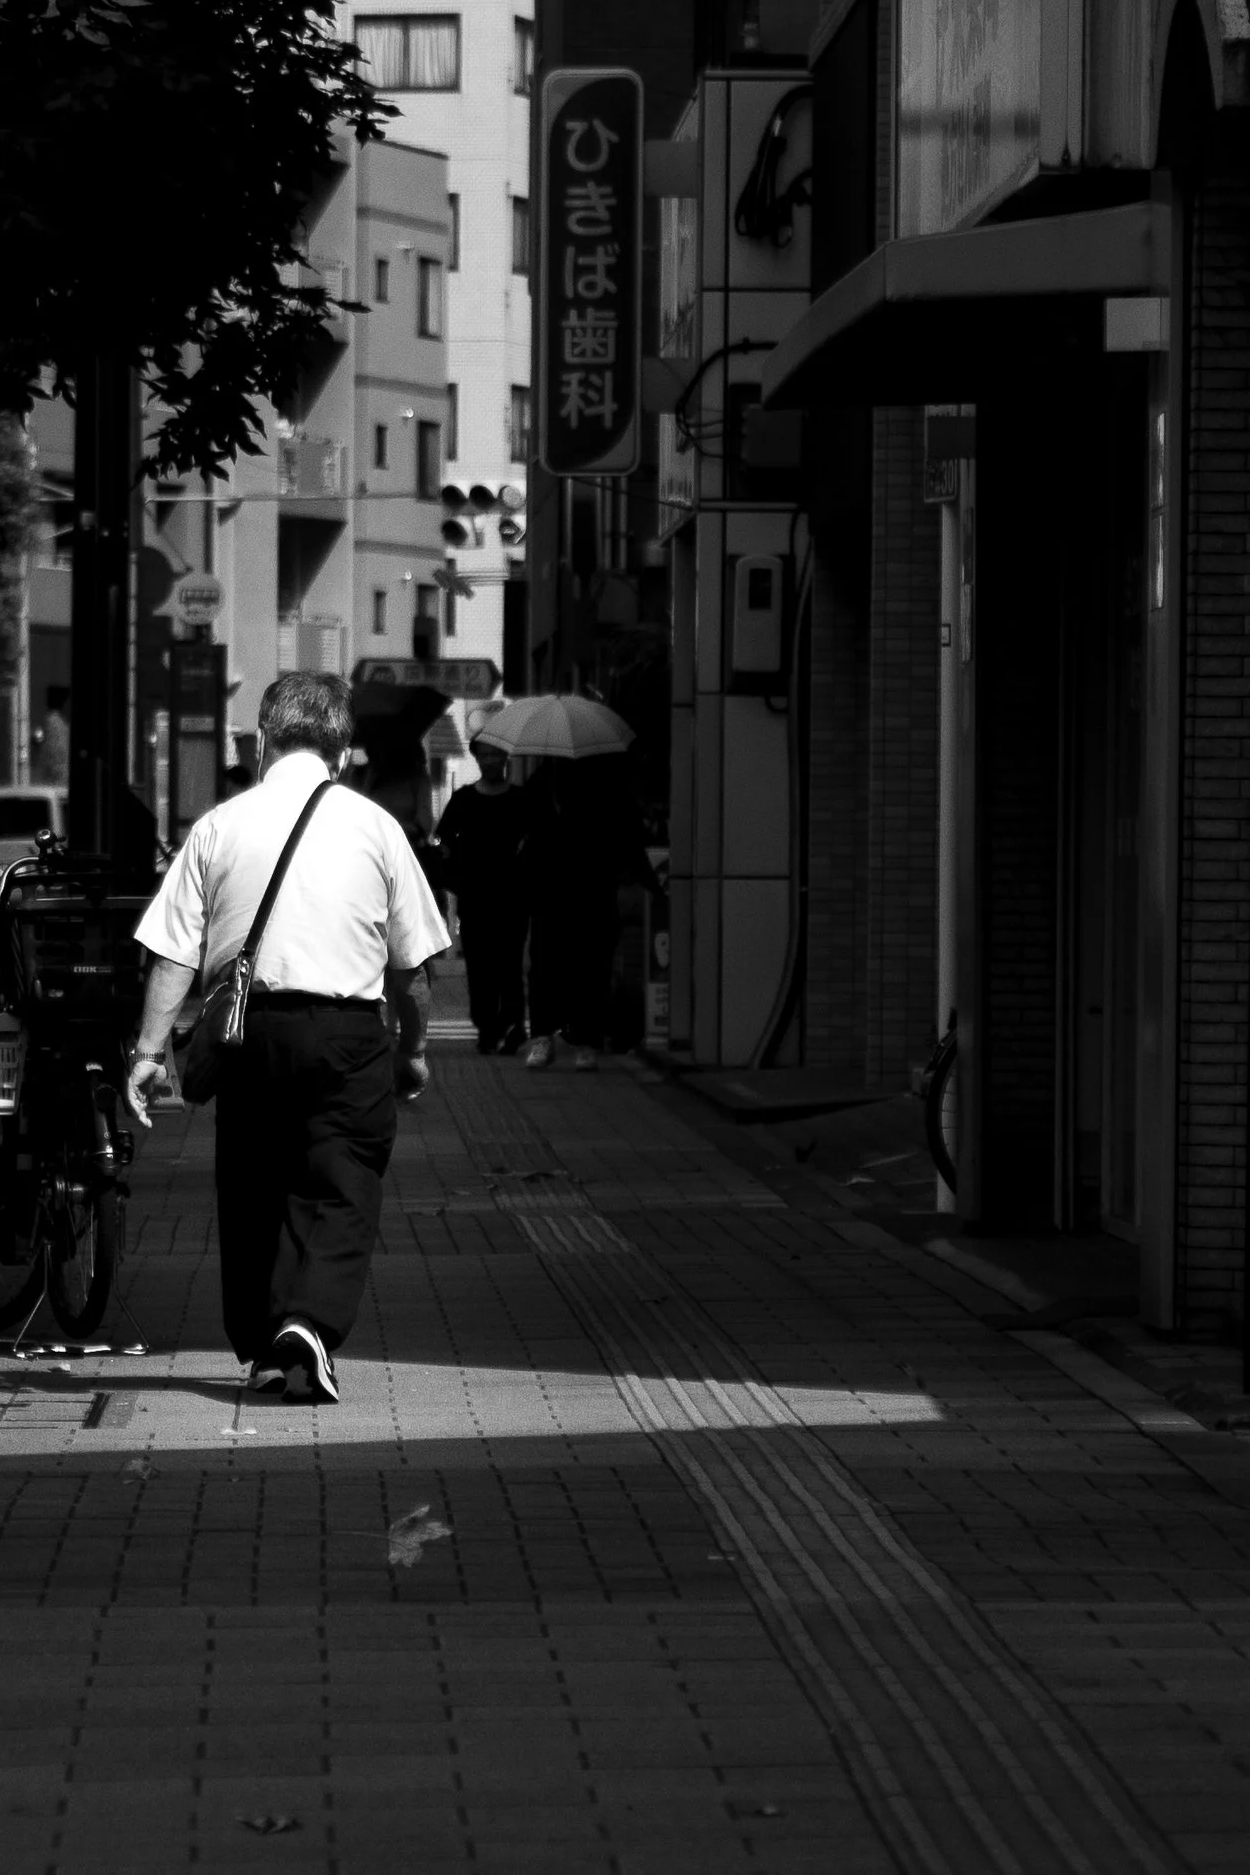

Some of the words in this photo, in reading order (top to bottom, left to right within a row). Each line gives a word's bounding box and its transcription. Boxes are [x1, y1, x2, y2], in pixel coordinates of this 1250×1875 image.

[558, 117, 620, 430] ひきば歯科
